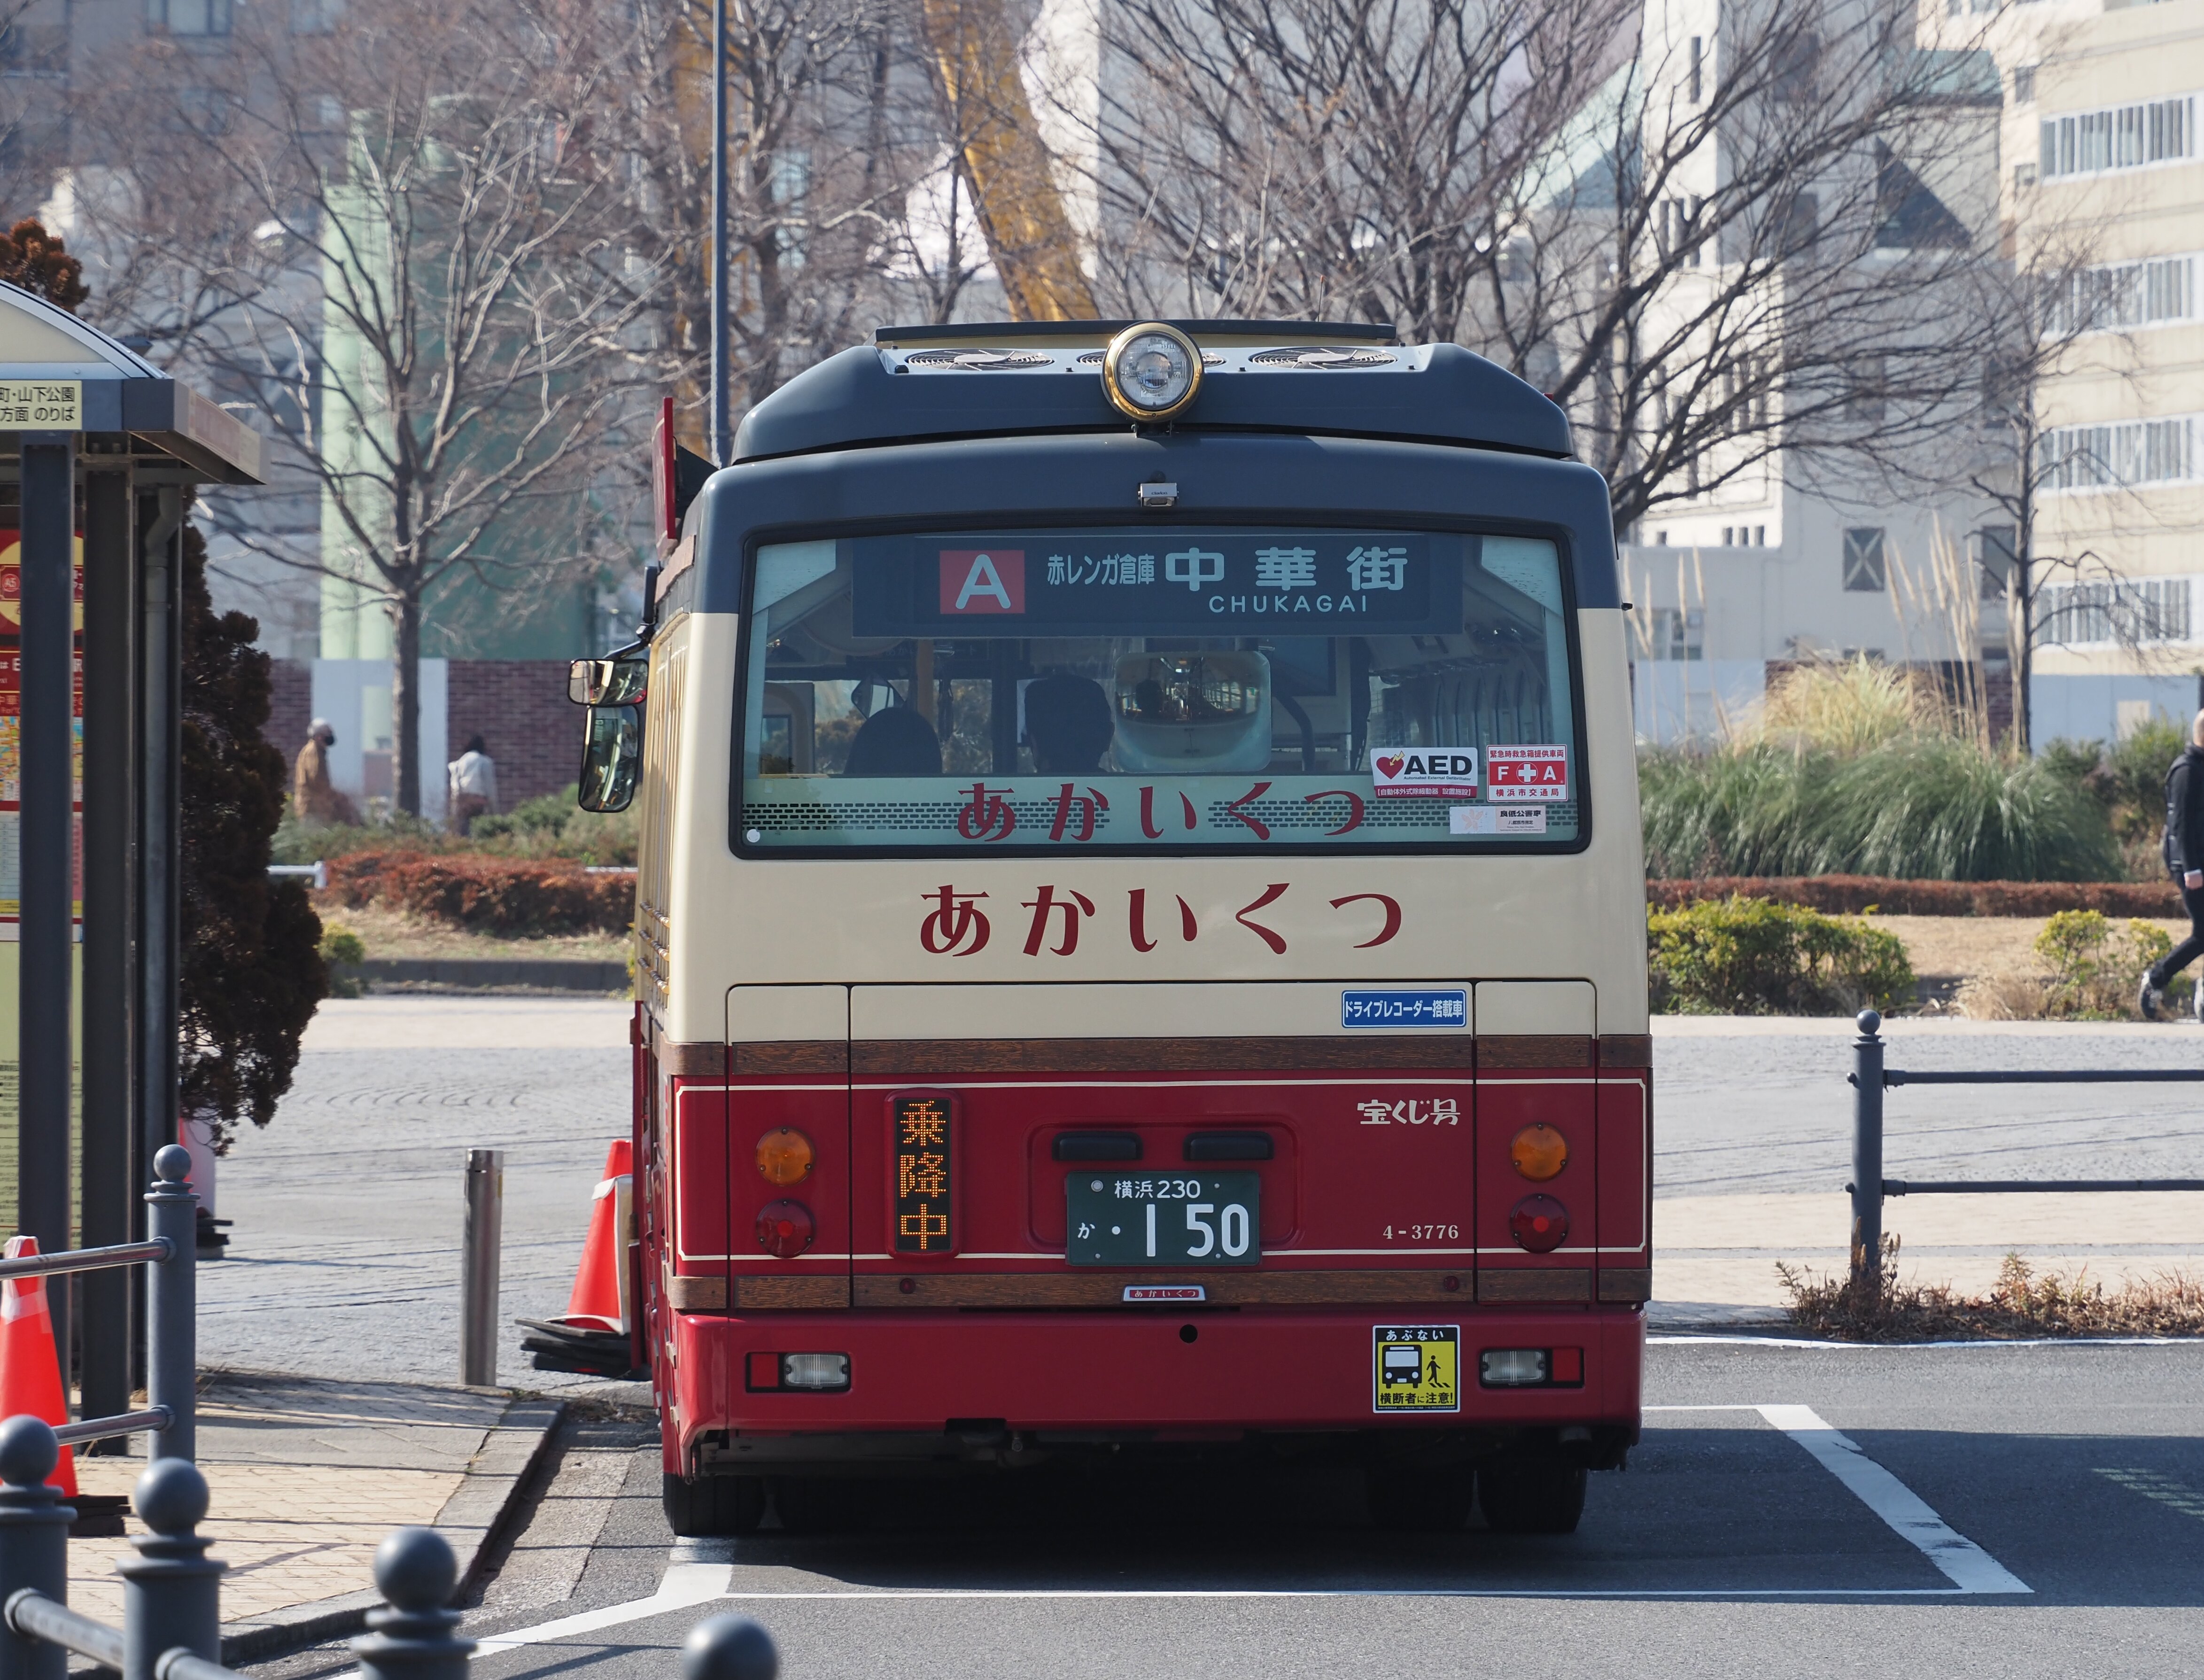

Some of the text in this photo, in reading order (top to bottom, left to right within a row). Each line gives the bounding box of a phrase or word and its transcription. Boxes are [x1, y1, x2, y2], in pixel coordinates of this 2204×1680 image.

[1048, 546, 1407, 591] 赤レンガ倉庫 中華街
[955, 554, 1010, 609] A
[1210, 595, 1367, 613] CHUKAGAI
[1490, 749, 1564, 759] 緊急時救急箱提供車両
[1404, 755, 1472, 775] AED
[1498, 766, 1556, 780] F A
[1496, 788, 1559, 797] 横浜市交通局
[957, 781, 1365, 841] あかいくつ
[920, 882, 1401, 957] あかいくつ
[1345, 1000, 1463, 1018] ドライブレコーダー搭載車
[1357, 1098, 1460, 1126] 宝くじ号
[900, 1101, 947, 1249] 乗降中
[1382, 1225, 1459, 1239] 4-3776
[1135, 1290, 1196, 1298] あかいくつ
[1386, 1329, 1444, 1341] あぶない
[1380, 1392, 1453, 1404] 横断者に注意!
